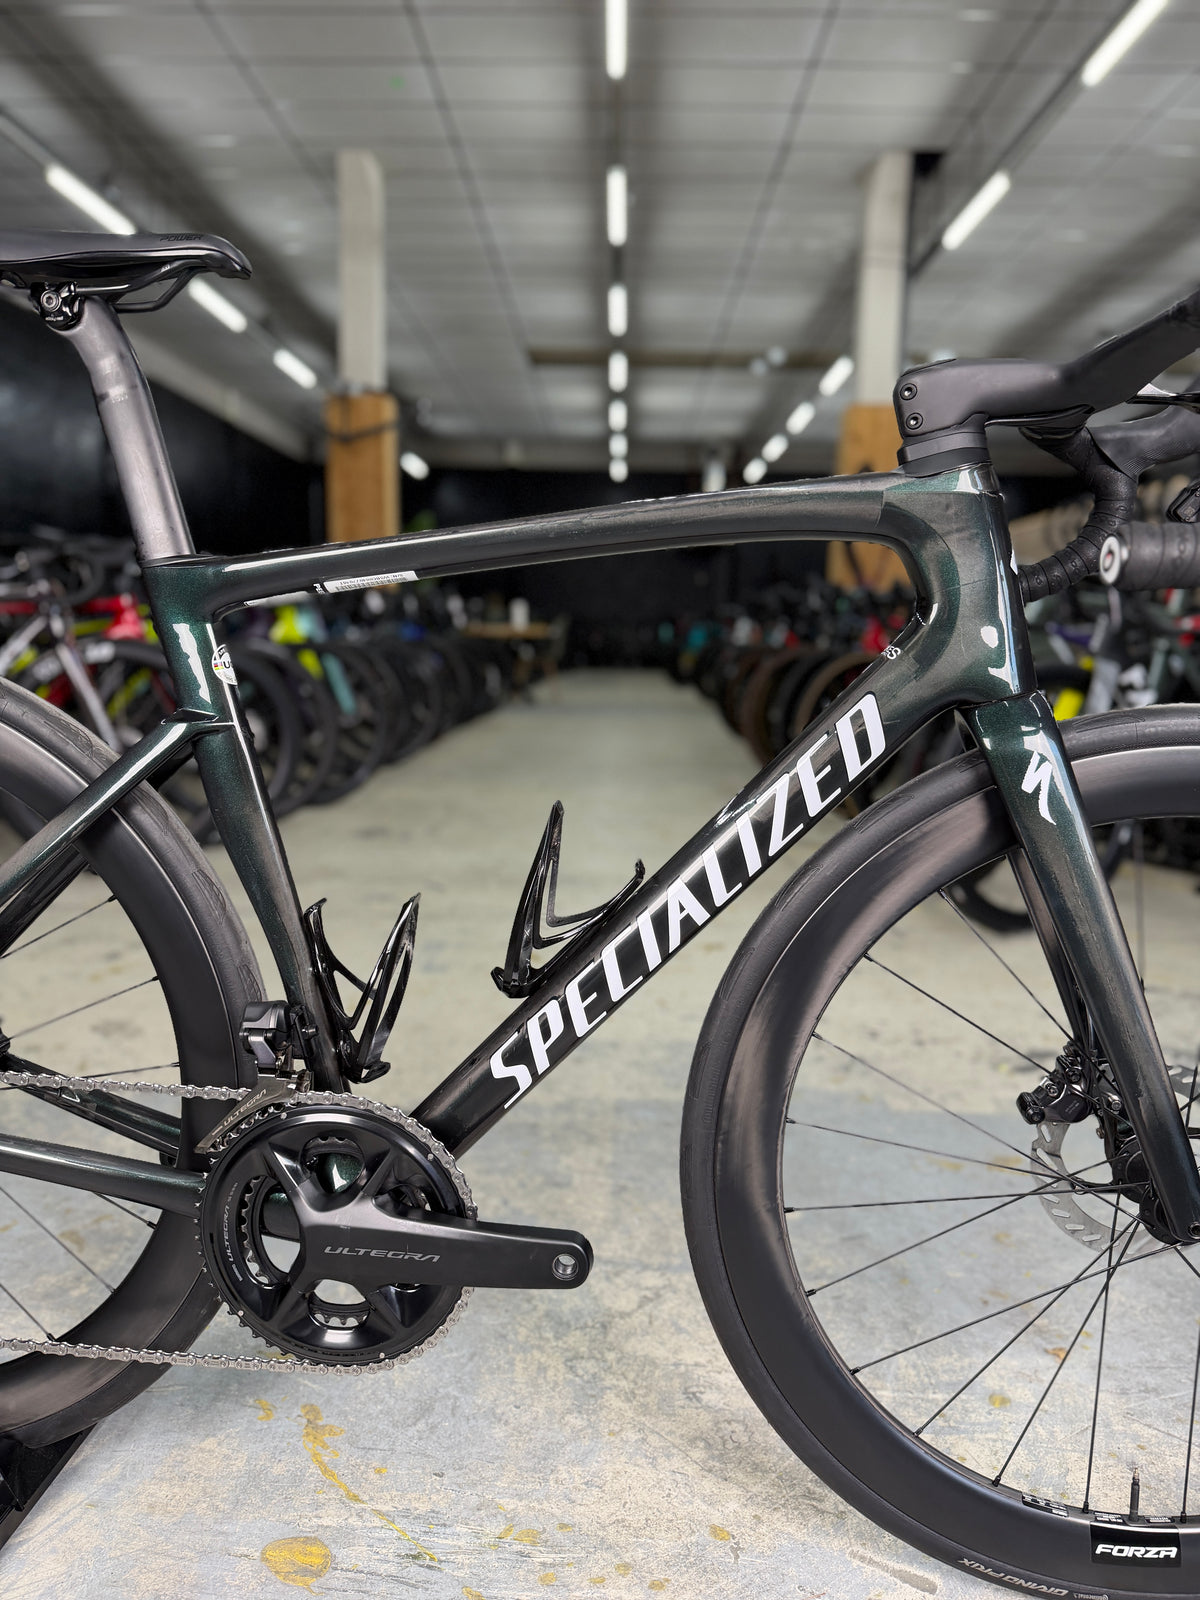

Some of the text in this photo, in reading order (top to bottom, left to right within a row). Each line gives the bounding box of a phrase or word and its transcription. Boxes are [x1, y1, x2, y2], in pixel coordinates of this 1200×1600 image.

[160, 232, 204, 242] POWER
[490, 693, 885, 1109] SPECIALIZED
[224, 1089, 266, 1126] ULTEGRA
[223, 1204, 234, 1262] ULTEGRA
[324, 1246, 440, 1262] ULTEGRA
[1095, 1543, 1178, 1559] FORZA
